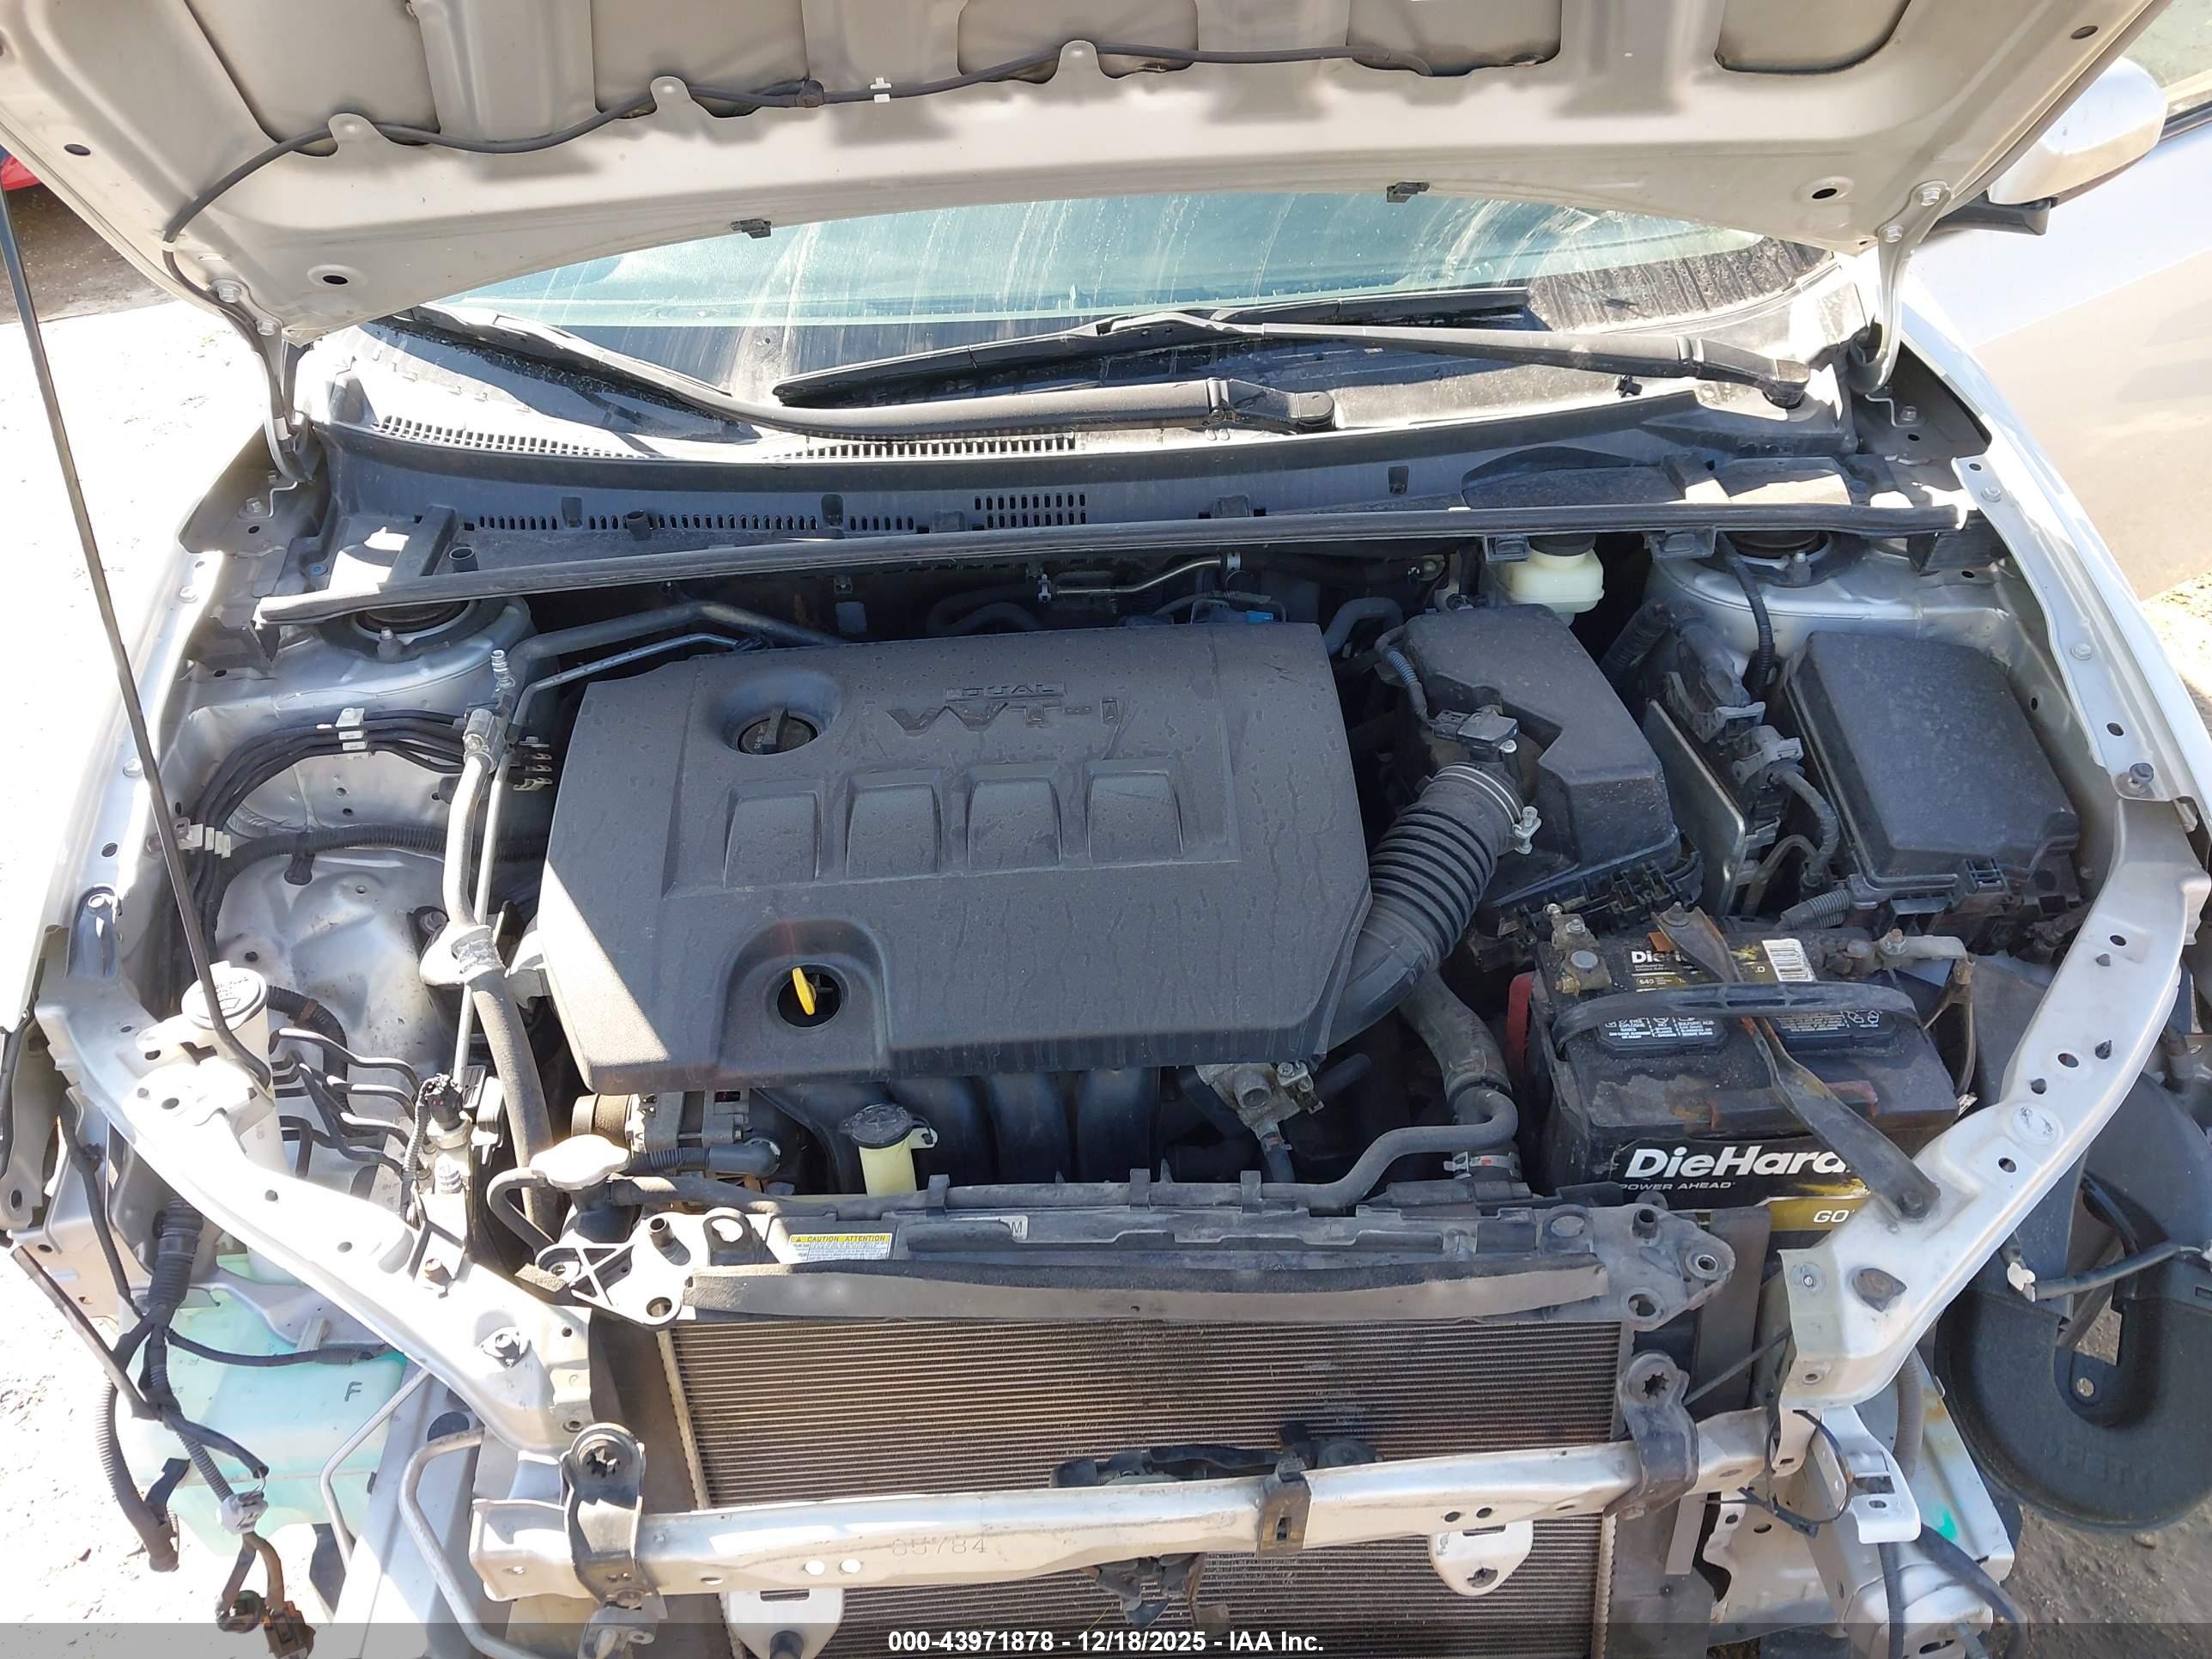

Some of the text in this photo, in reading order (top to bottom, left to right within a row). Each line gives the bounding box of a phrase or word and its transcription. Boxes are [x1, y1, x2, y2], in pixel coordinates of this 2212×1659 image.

[962, 684, 1055, 696] DUAL
[1678, 1182, 1731, 1190] AHEAD
[1814, 1209, 1855, 1224] GO
[344, 1381, 362, 1401] F
